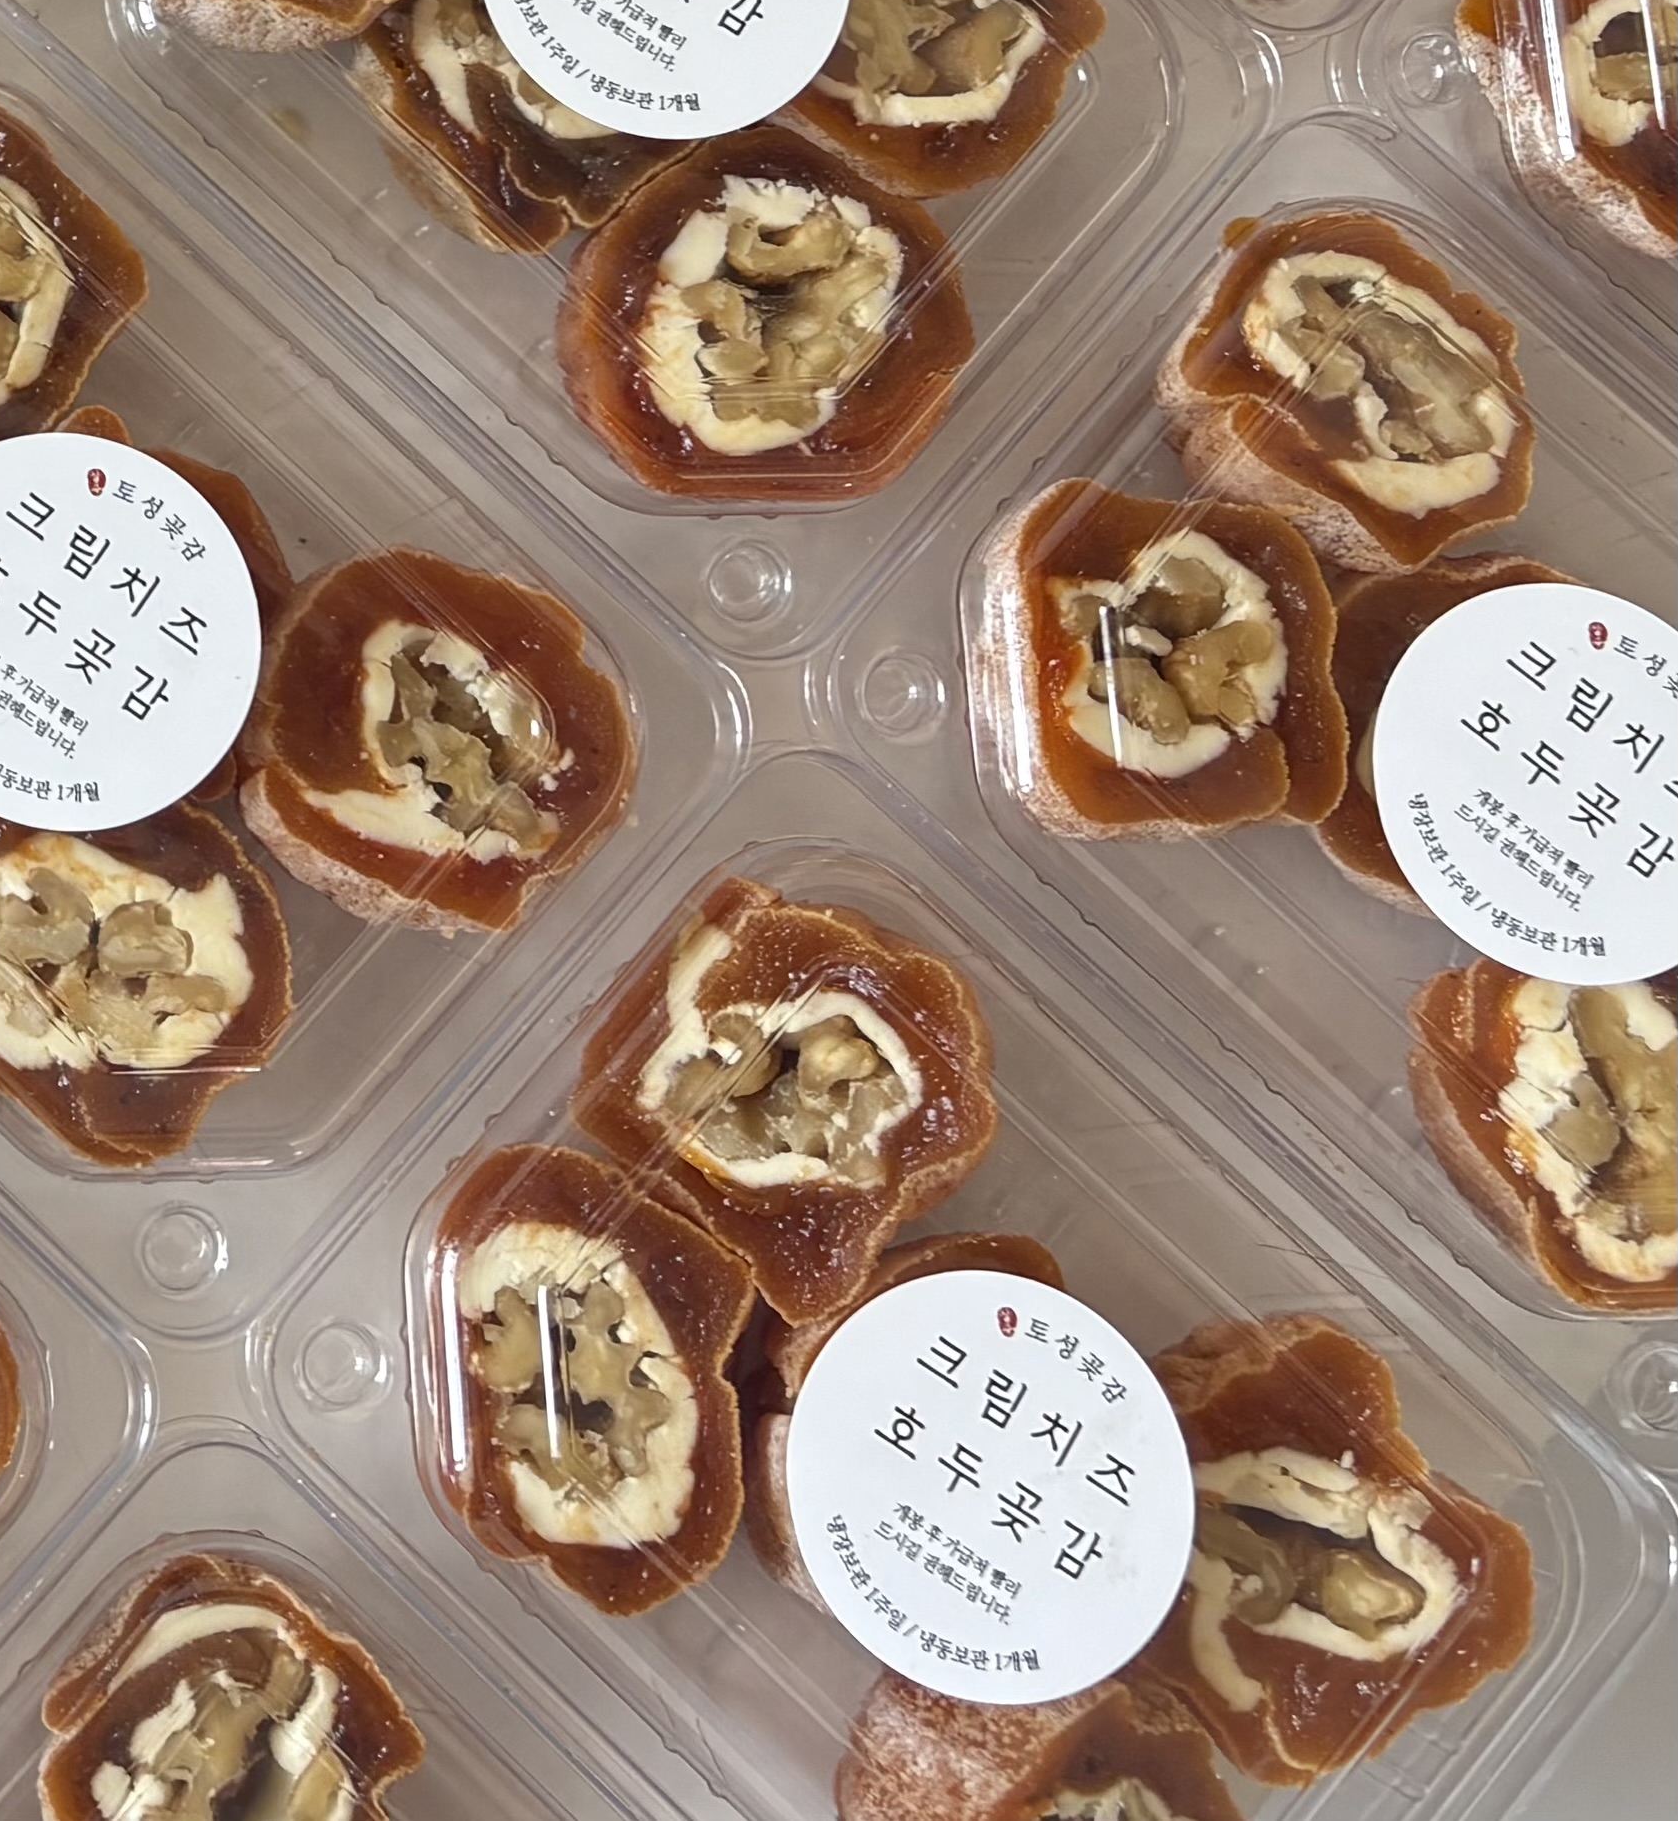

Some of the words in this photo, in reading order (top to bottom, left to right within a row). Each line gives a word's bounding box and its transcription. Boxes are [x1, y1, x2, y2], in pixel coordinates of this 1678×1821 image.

[541, 36, 580, 74] 1주일
[590, 73, 653, 110] 냉동보관
[659, 92, 701, 113] 1개월
[5, 491, 208, 656] 크림치즈
[112, 479, 206, 562] 토성곶감
[0, 664, 18, 681] 후
[16, 675, 60, 715] 가급적
[1506, 641, 1678, 799] 크림치
[57, 781, 100, 803] 1개월
[1460, 700, 1675, 879] 호두곶감
[1408, 793, 1449, 864] 냉장보관
[1491, 907, 1557, 952] 냉동보관
[916, 1335, 1136, 1507] 크림치즈
[1025, 1317, 1127, 1404] 토성곶감
[873, 1405, 1103, 1580] 호두곶감
[826, 1514, 872, 1590] 냉장보관
[919, 1629, 988, 1671] 냉동보관
